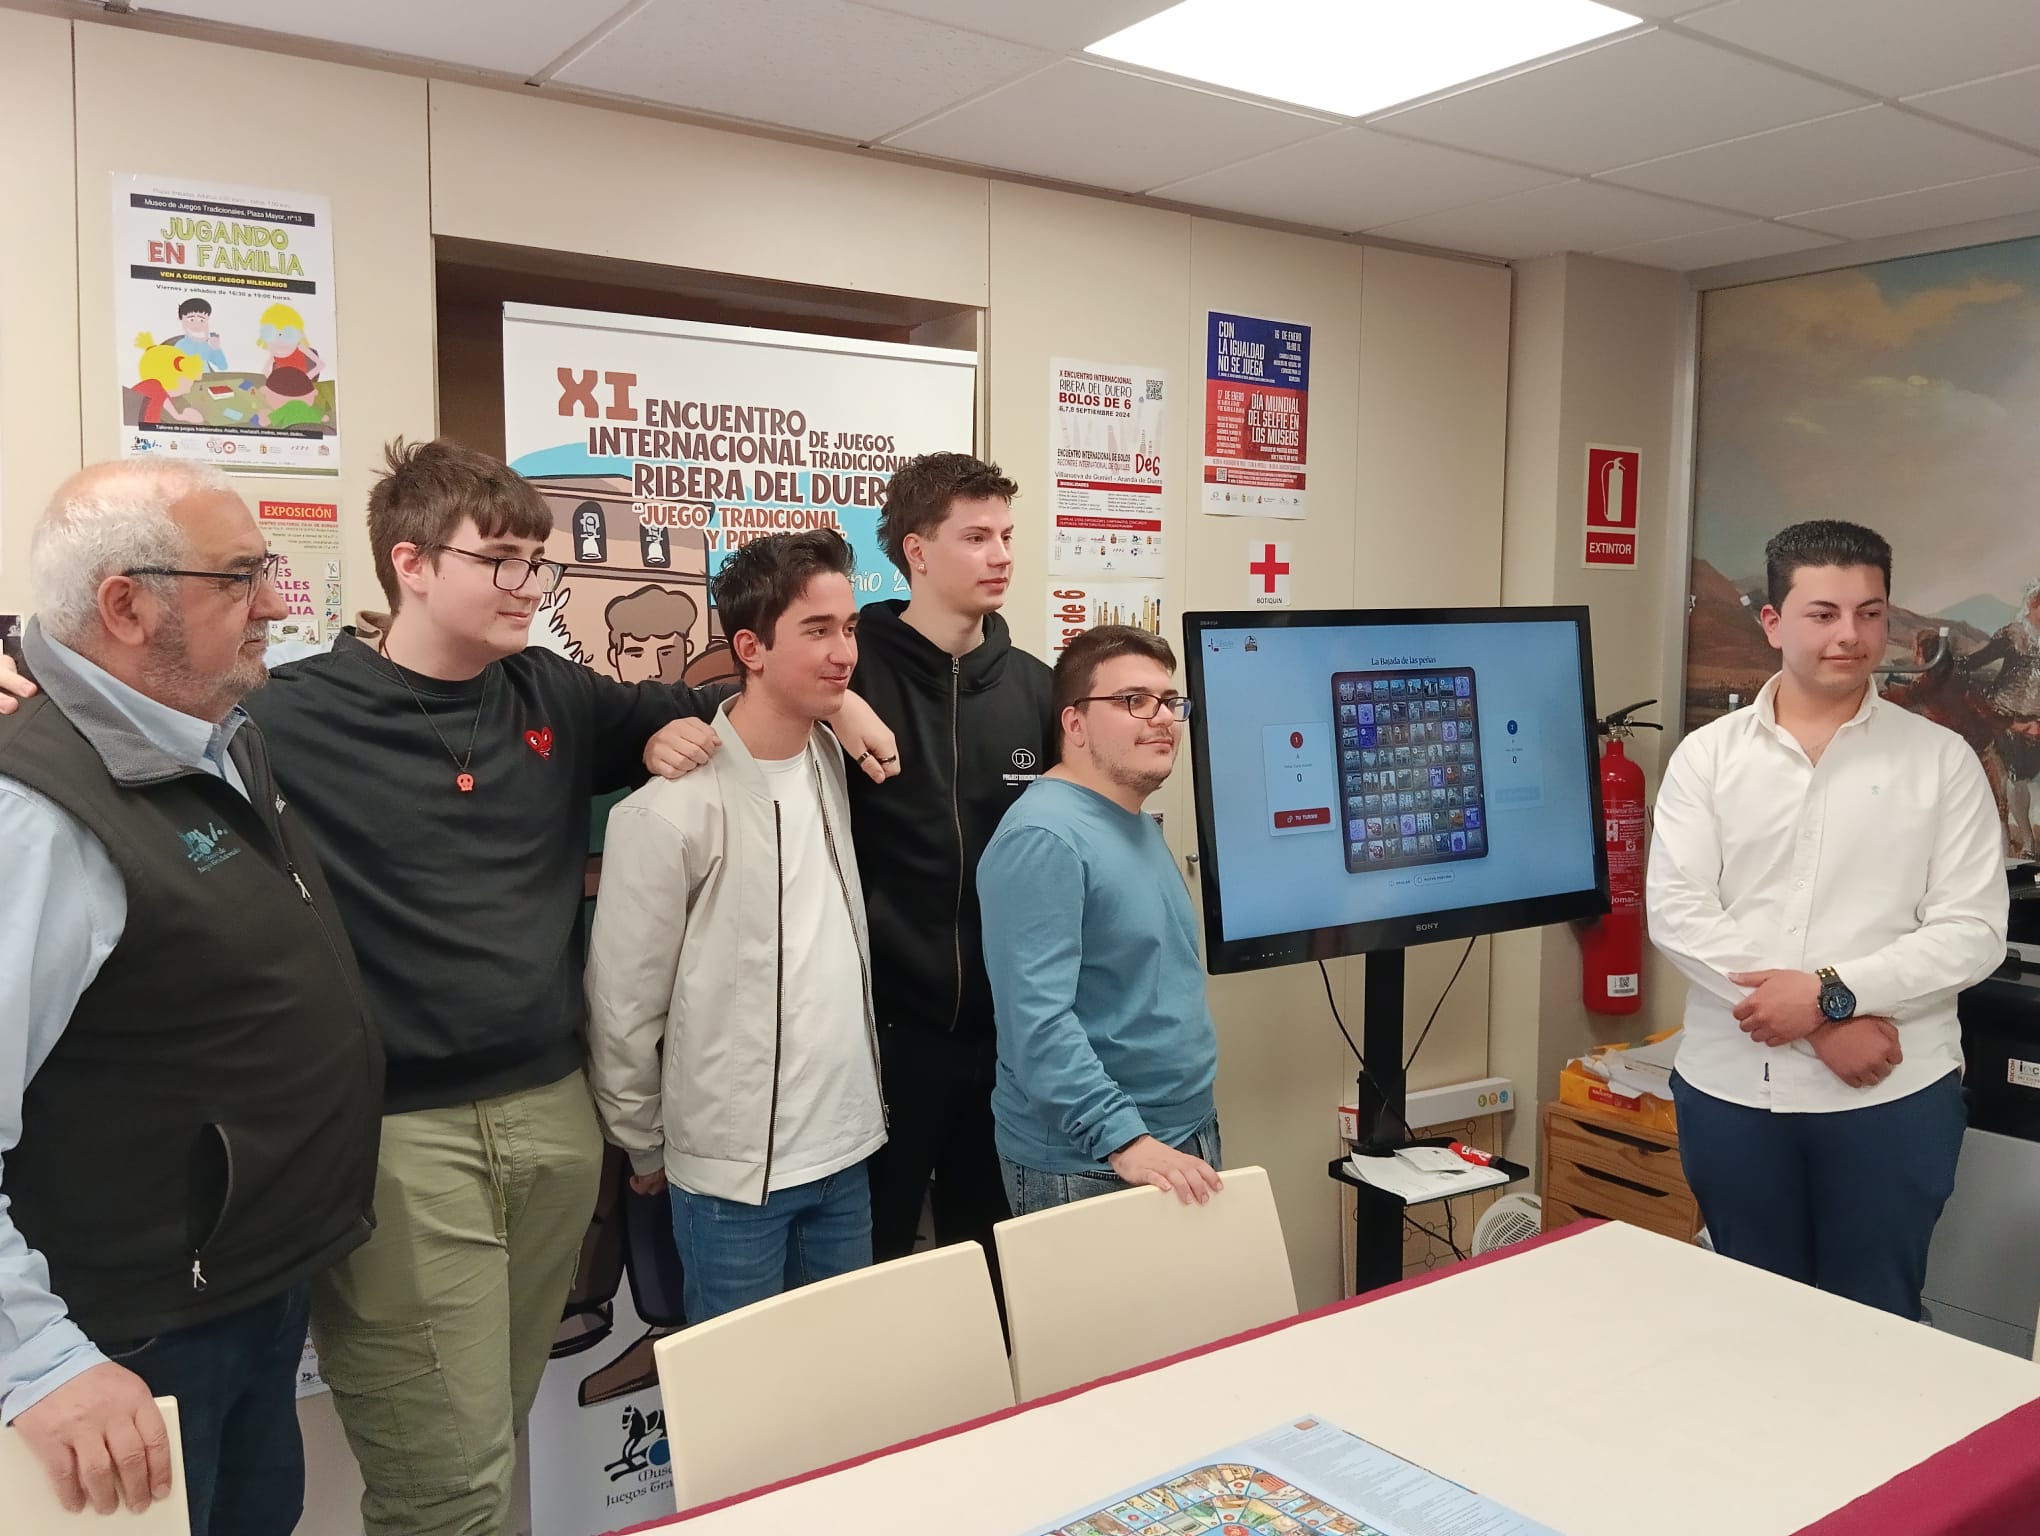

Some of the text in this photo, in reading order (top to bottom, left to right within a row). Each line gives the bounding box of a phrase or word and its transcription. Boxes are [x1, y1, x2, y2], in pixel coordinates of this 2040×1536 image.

[144, 198, 167, 207] Museo
[178, 203, 202, 211] Juegos
[247, 209, 265, 218] Plaza
[161, 216, 289, 250] JUGANDO
[147, 239, 305, 277] EN FAMILIA
[183, 273, 217, 282] CONOCER
[218, 276, 246, 285] JUEGOS
[246, 279, 288, 289] MILENARIOS
[1218, 320, 1235, 339] CON
[1218, 337, 1265, 361] LA IGUALDAD
[1217, 355, 1229, 372] NO
[1231, 357, 1241, 374] SE
[1242, 358, 1264, 377] JUEGA
[1059, 369, 1132, 385] X ENCUENTRO INTERNACIONAL
[557, 367, 638, 422] XI
[1059, 378, 1132, 399] RIBERA DEL DUERO
[1224, 390, 1231, 400] DE
[1059, 391, 1131, 410] BOLOS DE 6
[1251, 390, 1264, 411] DÍA
[1265, 394, 1300, 414] MUNDIAL
[645, 398, 806, 438] ENCUENTRO
[1075, 407, 1113, 417] SEPTIEMBRE
[1248, 409, 1300, 430] DEL SELFIE EN
[589, 426, 807, 467] INTERNACIONAL
[809, 430, 895, 453] DE JUEGOS
[1251, 426, 1266, 444] LOS
[1267, 428, 1299, 447] MUSEOS
[1057, 448, 1081, 459] ENCUENTRO
[1135, 453, 1161, 477] De6
[634, 463, 888, 507] RIBERA DEL DUER
[264, 504, 332, 519] EXPOSICIÓN
[718, 507, 840, 530] TRADICIONAL
[707, 530, 720, 549] Y
[1589, 542, 1632, 555] EXTINTOR
[1053, 590, 1086, 600] 6
[1053, 604, 1086, 623] de
[1371, 657, 1379, 666] La
[1401, 656, 1409, 665] de
[1409, 656, 1419, 665] las
[1296, 773, 1302, 783] 0
[1416, 922, 1439, 932] SONY
